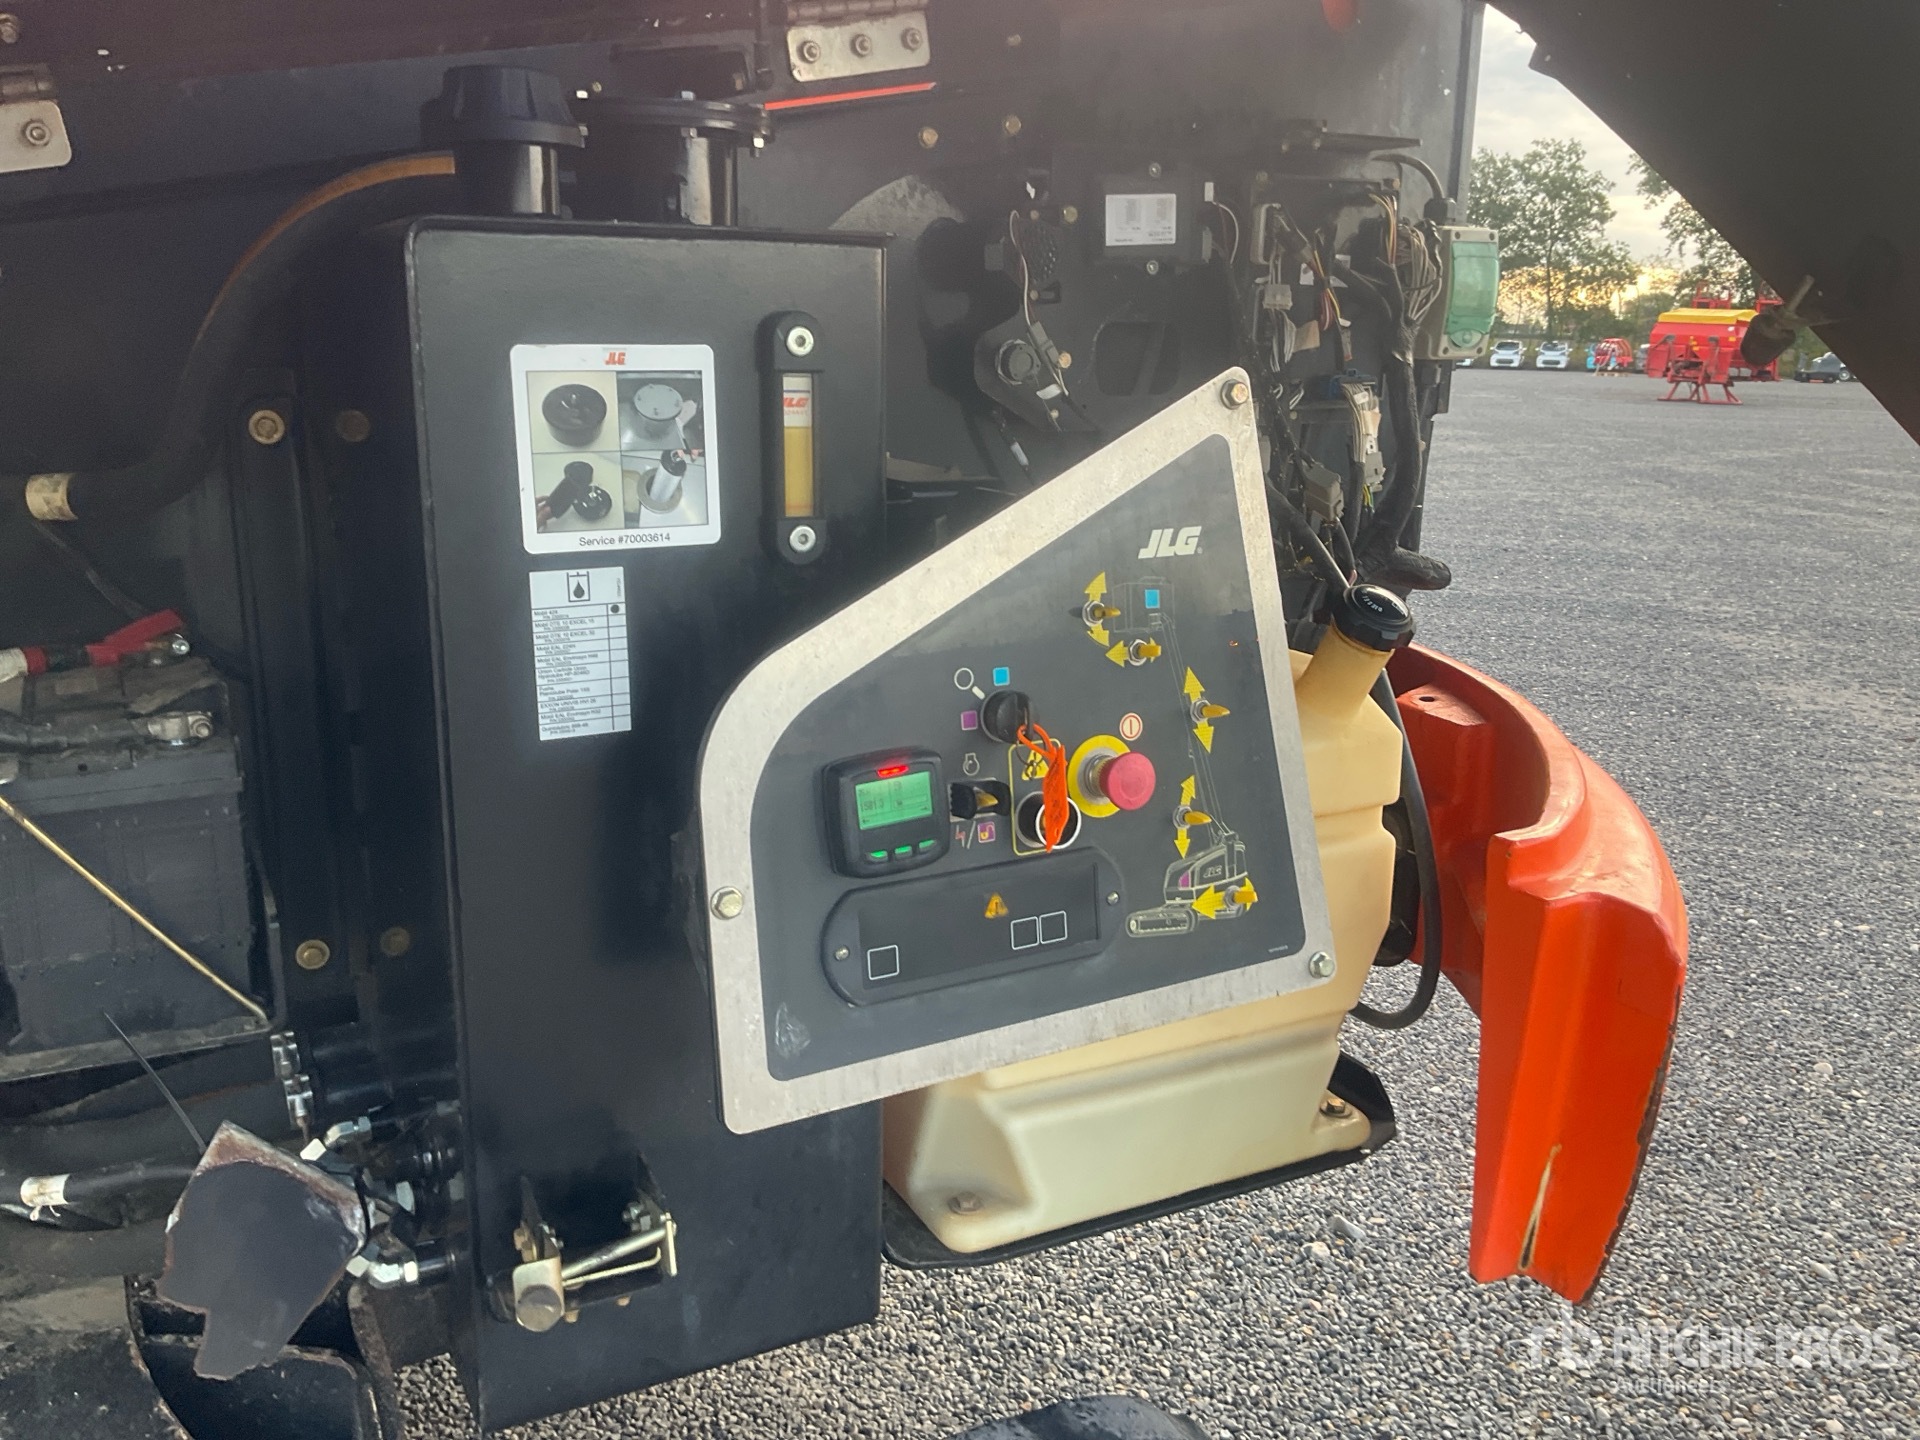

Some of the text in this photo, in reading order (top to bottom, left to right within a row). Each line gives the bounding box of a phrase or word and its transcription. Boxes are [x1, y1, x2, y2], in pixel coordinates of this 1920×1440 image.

[605, 351, 626, 366] JLG
[579, 533, 671, 547] Service #70003614
[1138, 525, 1202, 559] JLG
